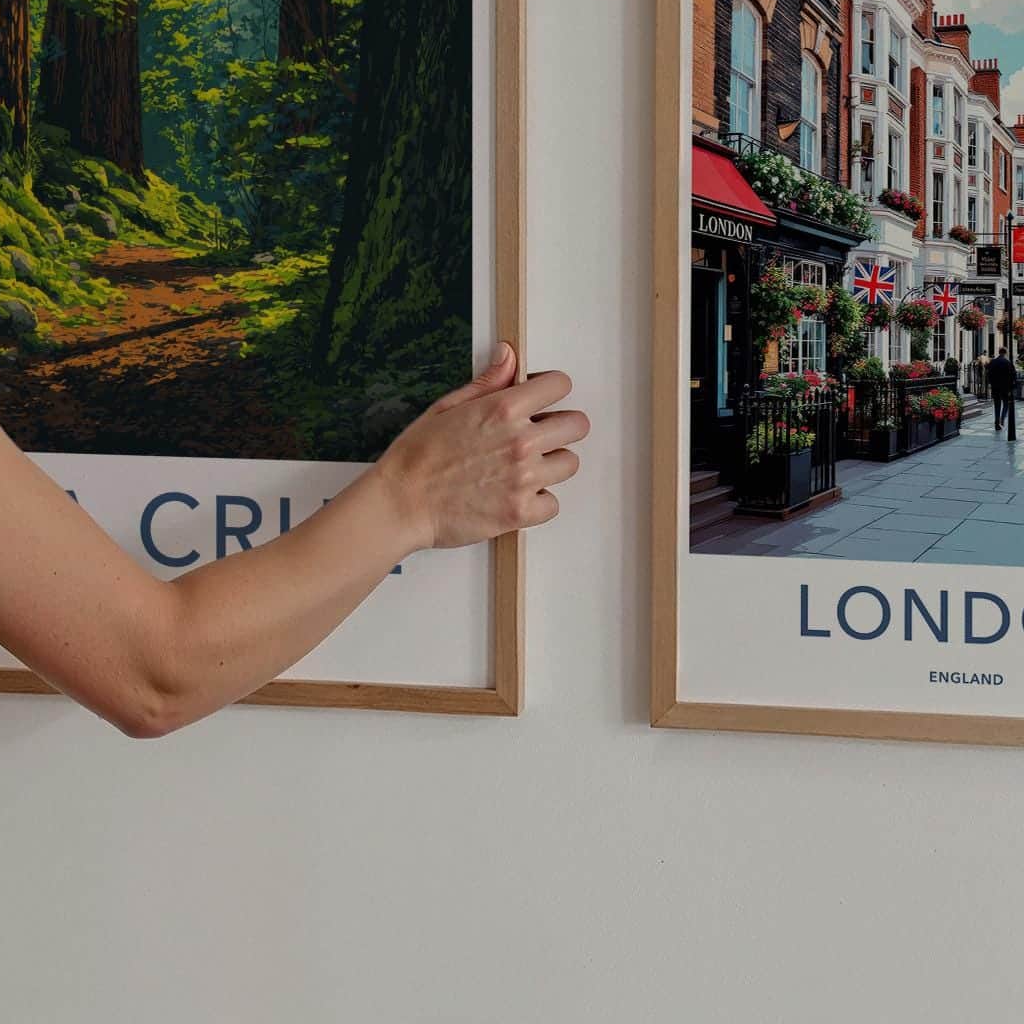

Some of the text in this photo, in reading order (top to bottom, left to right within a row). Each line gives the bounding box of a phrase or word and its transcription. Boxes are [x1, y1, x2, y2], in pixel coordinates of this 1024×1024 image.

[698, 213, 753, 242] LONDON
[800, 584, 1024, 645] LOND
[929, 671, 1004, 686] ENGLAND
